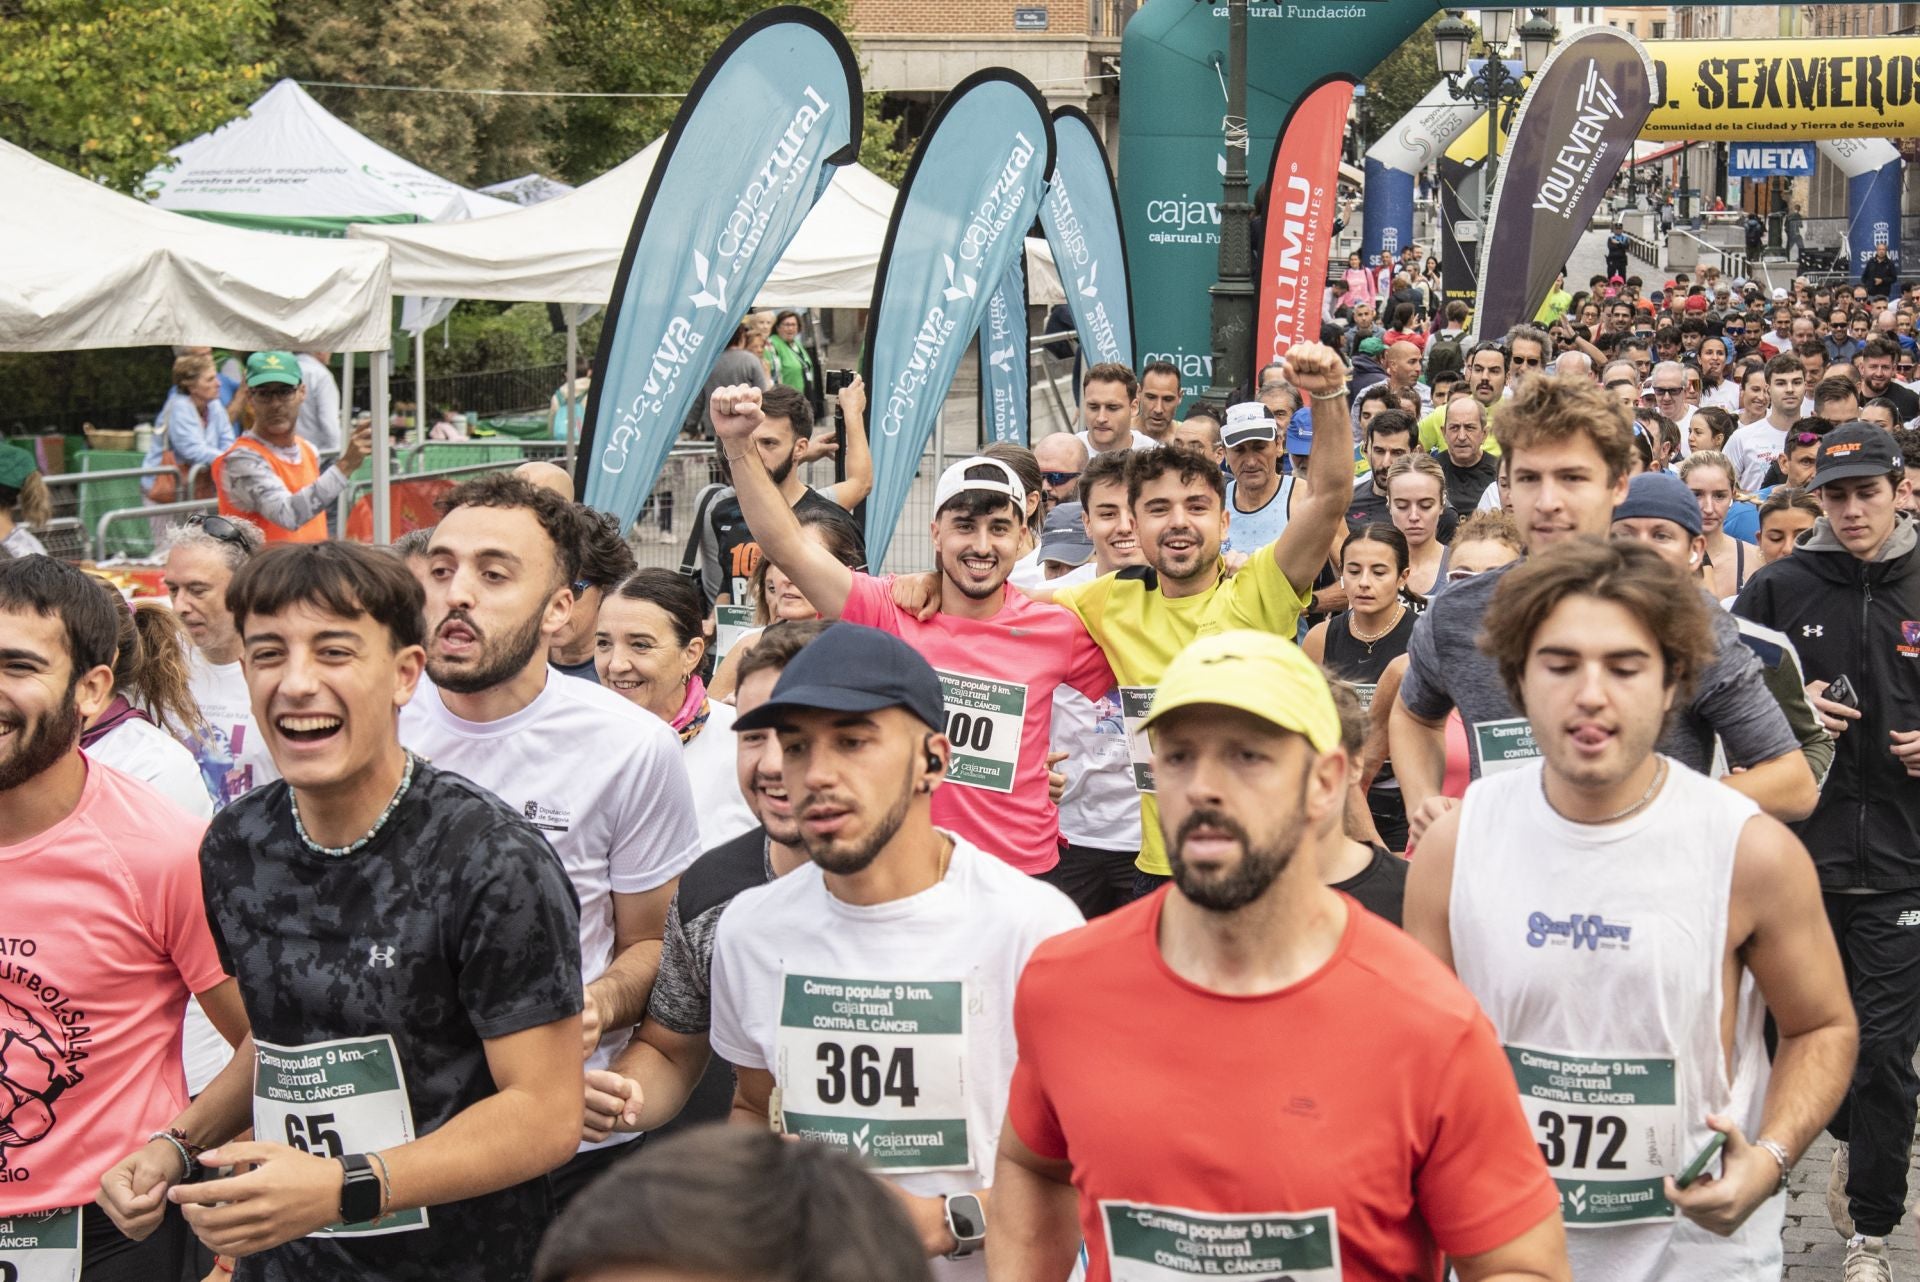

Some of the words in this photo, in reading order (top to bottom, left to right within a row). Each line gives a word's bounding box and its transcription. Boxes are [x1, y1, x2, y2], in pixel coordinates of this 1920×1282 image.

[1287, 5, 1366, 19] Fundación
[1696, 55, 1920, 115] SEXMERO
[1434, 117, 1463, 144] 2025
[1644, 122, 1712, 132] Comunidad
[1715, 122, 1729, 131] de
[1732, 121, 1743, 131] la
[1746, 121, 1788, 131] Ciudad
[1791, 123, 1798, 133] y
[1801, 120, 1836, 131] Tierra
[1840, 120, 1853, 130] de
[1857, 119, 1905, 132] Segovia
[1832, 137, 1855, 158] 025
[1737, 149, 1808, 170] META
[181, 176, 234, 185] contra
[237, 176, 253, 185] el
[717, 85, 830, 257] cajarural
[1563, 182, 1585, 219] SPORTS
[1583, 141, 1608, 184] SERVICES
[960, 131, 1035, 261] cajarural
[1146, 193, 1222, 231] cajav
[1148, 231, 1203, 245] cajarural
[1295, 275, 1310, 345] UNNING
[1303, 186, 1324, 267] BERRIES
[882, 306, 945, 437] cajaviva
[602, 315, 692, 474] cajaviva
[937, 675, 960, 686] arrera
[961, 679, 991, 693] popular
[992, 684, 998, 693] 9
[998, 684, 1011, 696] km.
[950, 687, 990, 701] cajarural
[964, 699, 973, 707] EL
[974, 699, 1001, 712] CÁNCER
[1492, 726, 1524, 738] Carrera
[1503, 748, 1536, 759] CONTRA
[960, 762, 1001, 777] cajarural
[0, 962, 70, 1014] UTBOL
[803, 979, 843, 997] Carrera
[845, 983, 892, 1001] popular
[894, 985, 904, 999] 9
[907, 985, 933, 1000] km.
[832, 1001, 894, 1018] cajarural
[813, 1015, 855, 1029] CONTRA
[857, 1018, 870, 1031] EL
[871, 1017, 919, 1033] CÁNCER
[281, 1054, 323, 1074] popular
[326, 1051, 336, 1065] 9
[339, 1049, 365, 1062] km.
[1520, 1052, 1560, 1071] Carrera
[1561, 1061, 1611, 1077] popular
[1612, 1062, 1622, 1076] 9
[1624, 1063, 1649, 1076] km.
[277, 1069, 328, 1089] cajarural
[815, 1041, 920, 1108] 364
[1548, 1074, 1612, 1091] cajarural
[268, 1086, 293, 1101] CONTRA
[294, 1090, 306, 1101] EL
[305, 1082, 356, 1101] CÁNCER
[1531, 1085, 1571, 1102] CONTRA
[1572, 1091, 1587, 1103] EL
[1588, 1091, 1636, 1104] CÁNCER
[284, 1112, 345, 1159] 65
[873, 1131, 944, 1149] cajarural
[1537, 1110, 1628, 1170] 372
[873, 1148, 921, 1157] Fundación
[1590, 1188, 1654, 1208] cajarural
[1136, 1212, 1187, 1234] Carrera
[1188, 1223, 1247, 1242] popular
[1251, 1223, 1263, 1238] 9
[0, 1236, 39, 1248] ÁNCER
[1175, 1238, 1253, 1259] cajarural
[1154, 1250, 1201, 1273] CONTRA
[1203, 1258, 1222, 1273] EL
[1223, 1257, 1283, 1274] CÁNCER
